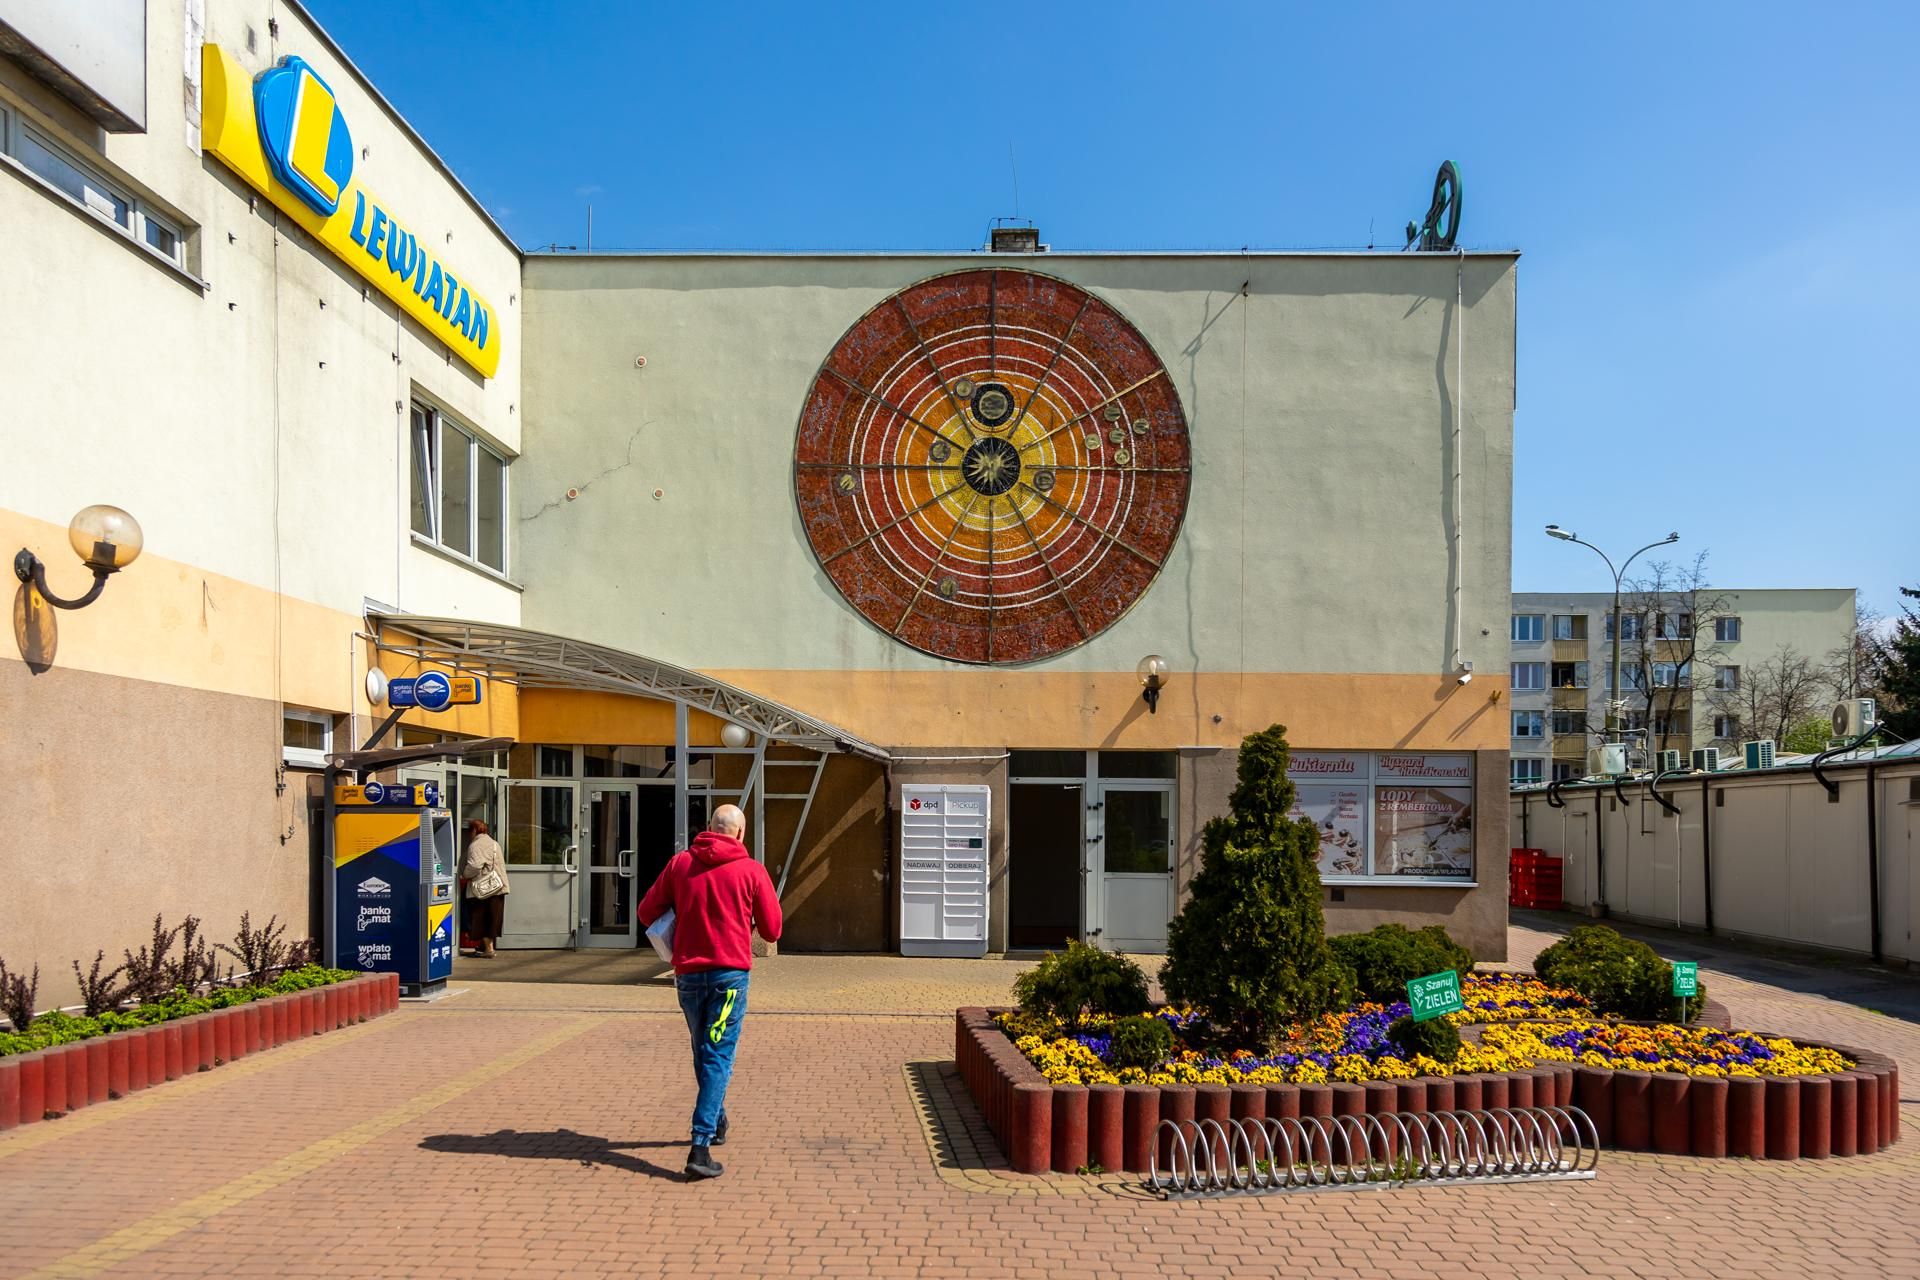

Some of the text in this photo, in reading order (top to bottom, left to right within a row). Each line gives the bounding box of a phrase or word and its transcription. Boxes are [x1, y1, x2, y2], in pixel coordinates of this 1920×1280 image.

[350, 190, 490, 350] LEWIATAN
[1287, 757, 1355, 772] Cukiernia
[1381, 755, 1425, 770] Ryszard
[1380, 790, 1416, 802] LODY
[923, 801, 939, 809] dpd
[1380, 803, 1453, 812] Z REMBERTOWA
[360, 905, 391, 915] banko
[371, 914, 391, 923] mat
[358, 944, 391, 956] wpłato
[372, 953, 391, 961] mat
[1425, 975, 1454, 991] Szanuj
[1424, 987, 1458, 1010] ZIELEŃ
